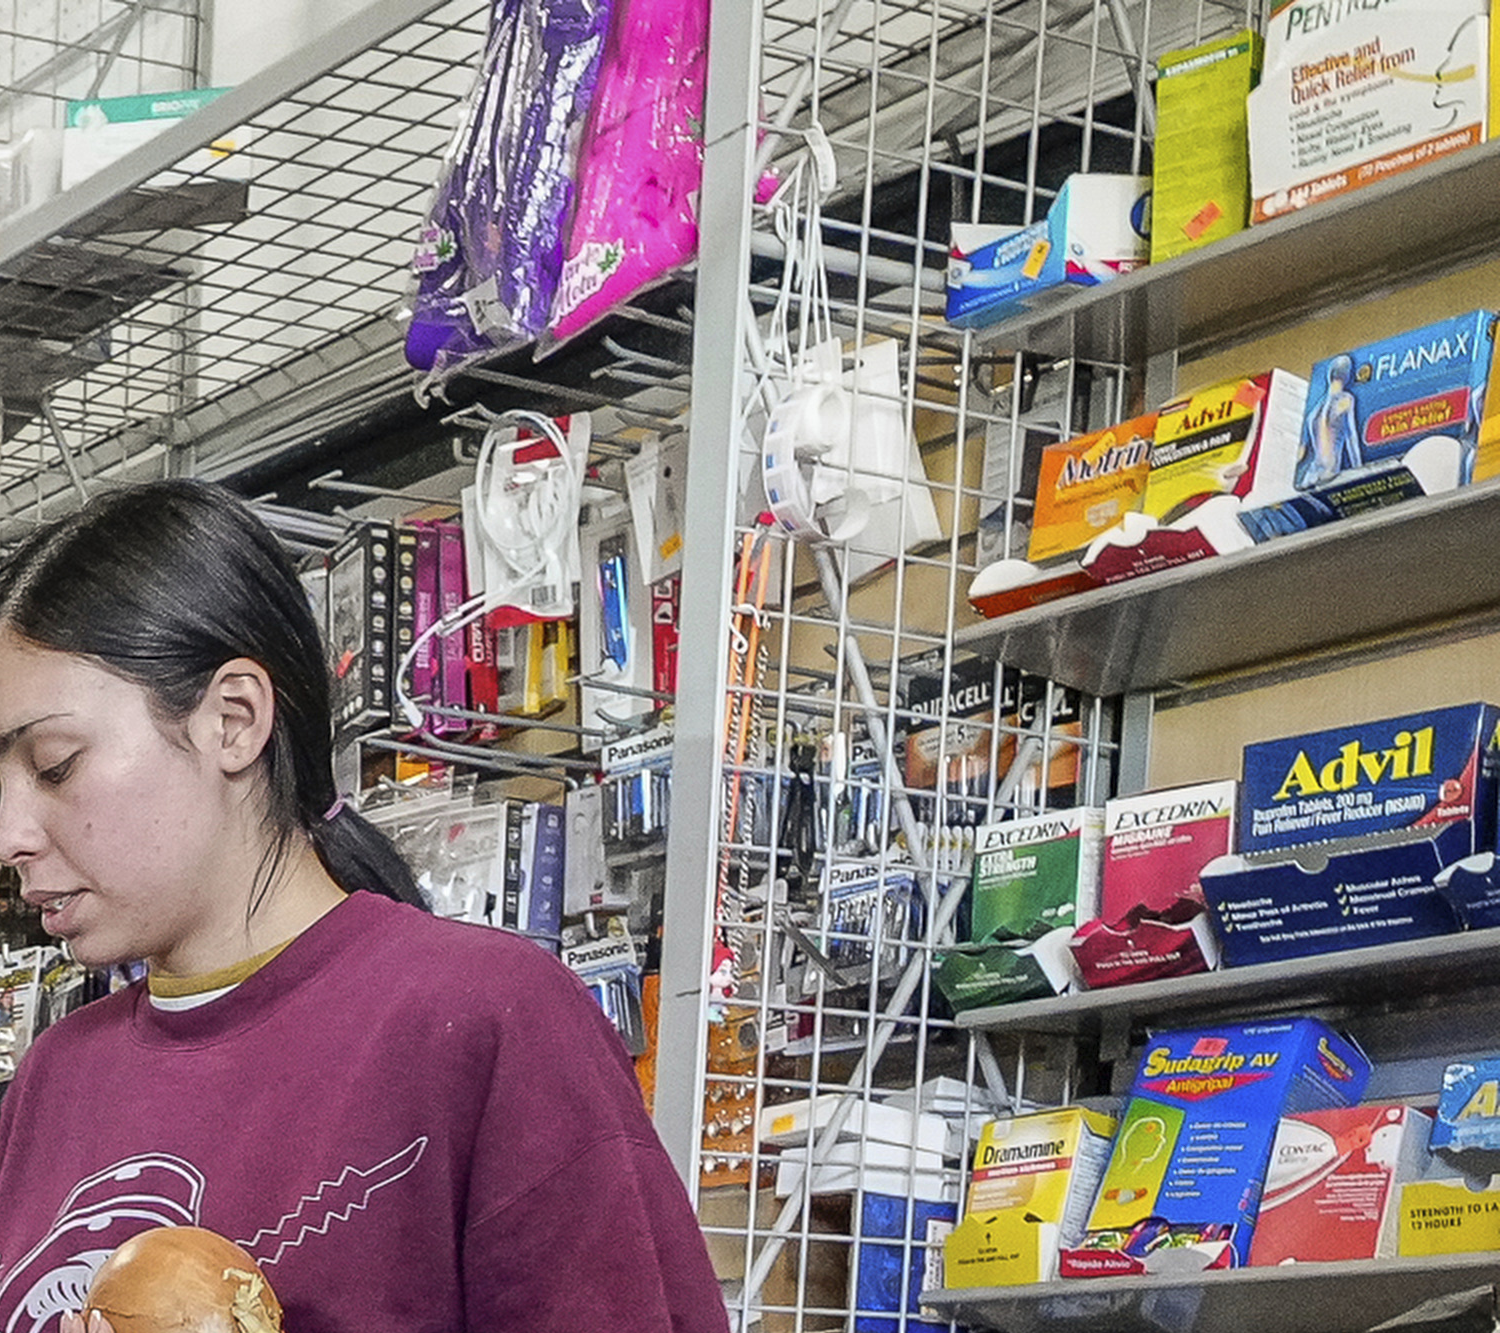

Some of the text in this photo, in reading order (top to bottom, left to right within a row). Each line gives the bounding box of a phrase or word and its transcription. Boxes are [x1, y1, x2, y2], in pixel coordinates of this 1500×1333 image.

[1291, 36, 1382, 83] Effective and
[1291, 46, 1416, 104] Quick Relief from
[1375, 331, 1470, 381] FLANAX
[1175, 400, 1234, 434] Advil
[1380, 408, 1453, 438] Pain Relief
[1272, 726, 1435, 801] Advil
[1114, 797, 1223, 832] EXCEDRIN
[1336, 793, 1356, 807] 200
[984, 818, 1074, 850] EXCEDRIN
[978, 856, 1038, 879] STRENGTH
[568, 942, 630, 965] Panasonic
[1143, 1046, 1280, 1077] Sudagrip AV
[982, 1139, 1066, 1166] Dramamine
[1410, 1204, 1482, 1219] STRENGTH TO
[1425, 1218, 1462, 1229] HOURS
